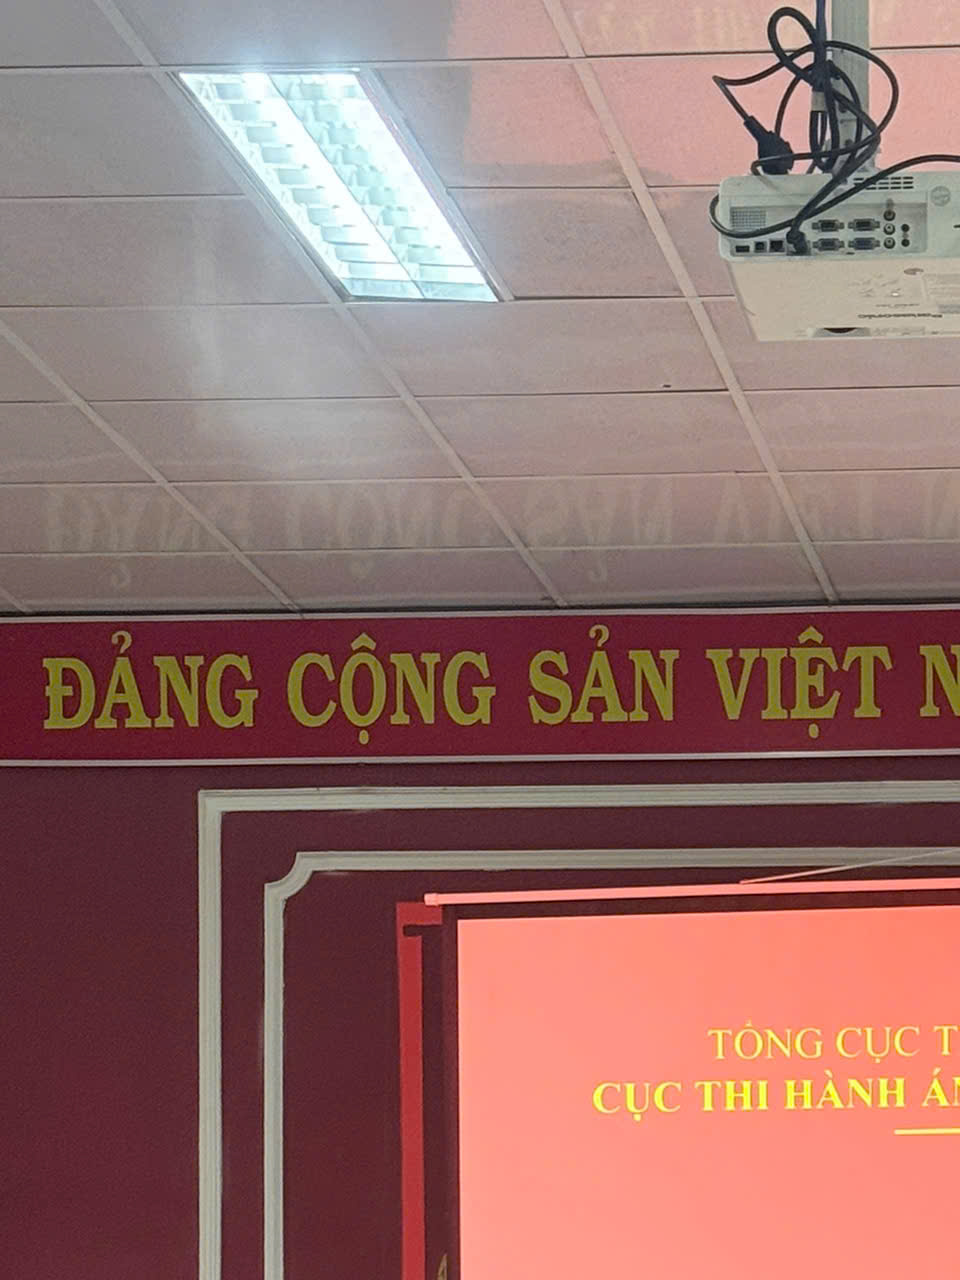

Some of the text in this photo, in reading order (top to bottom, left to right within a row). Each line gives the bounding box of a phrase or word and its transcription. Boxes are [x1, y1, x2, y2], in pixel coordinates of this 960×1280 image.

[43, 630, 258, 730] ĐẢNG
[287, 633, 497, 744] CỘNG
[527, 625, 681, 725] SẢN
[706, 625, 893, 739] VIỆT
[707, 1019, 825, 1062] TỔNG
[834, 1024, 921, 1064] CỤC
[592, 1080, 682, 1122] CỤC
[695, 1079, 769, 1113] THI
[784, 1069, 906, 1111] HÀNH
